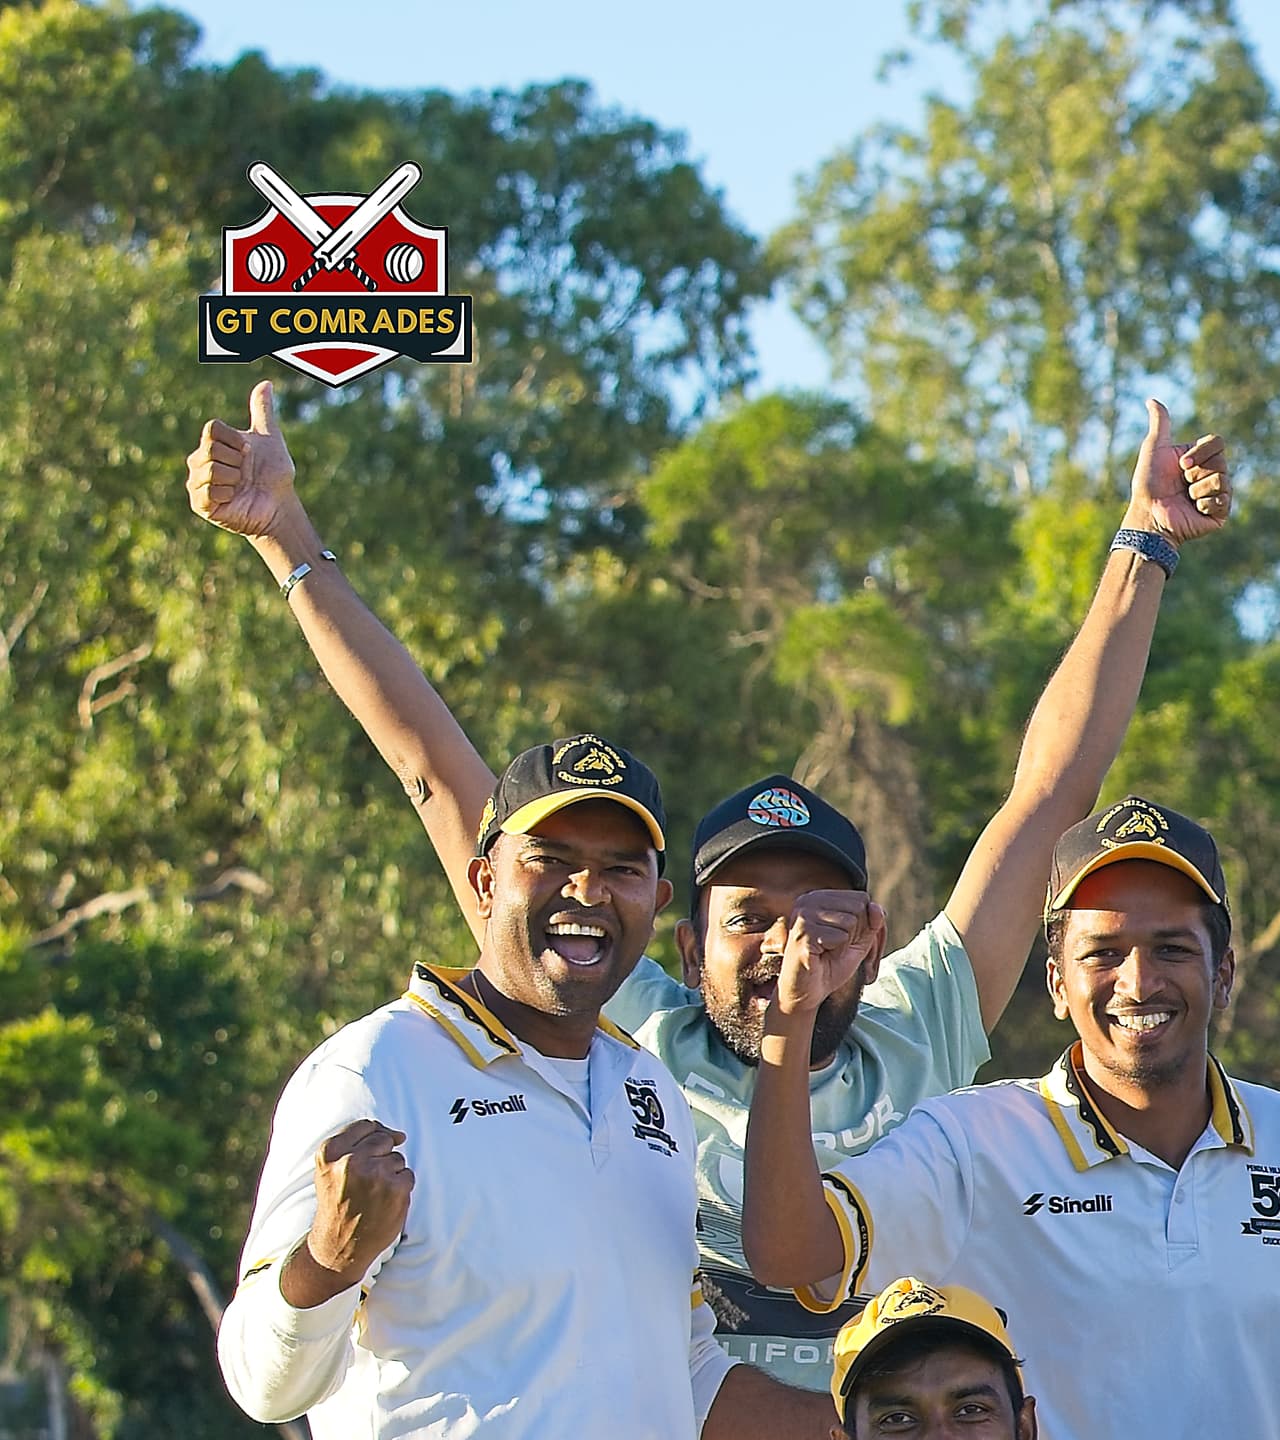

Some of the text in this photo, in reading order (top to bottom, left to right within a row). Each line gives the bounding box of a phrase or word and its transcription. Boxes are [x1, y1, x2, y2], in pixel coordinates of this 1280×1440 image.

[749, 787, 811, 817] RAD
[748, 807, 811, 827] DAD
[473, 1093, 528, 1117] Sinalli
[1048, 1193, 1113, 1215] Sinalli
